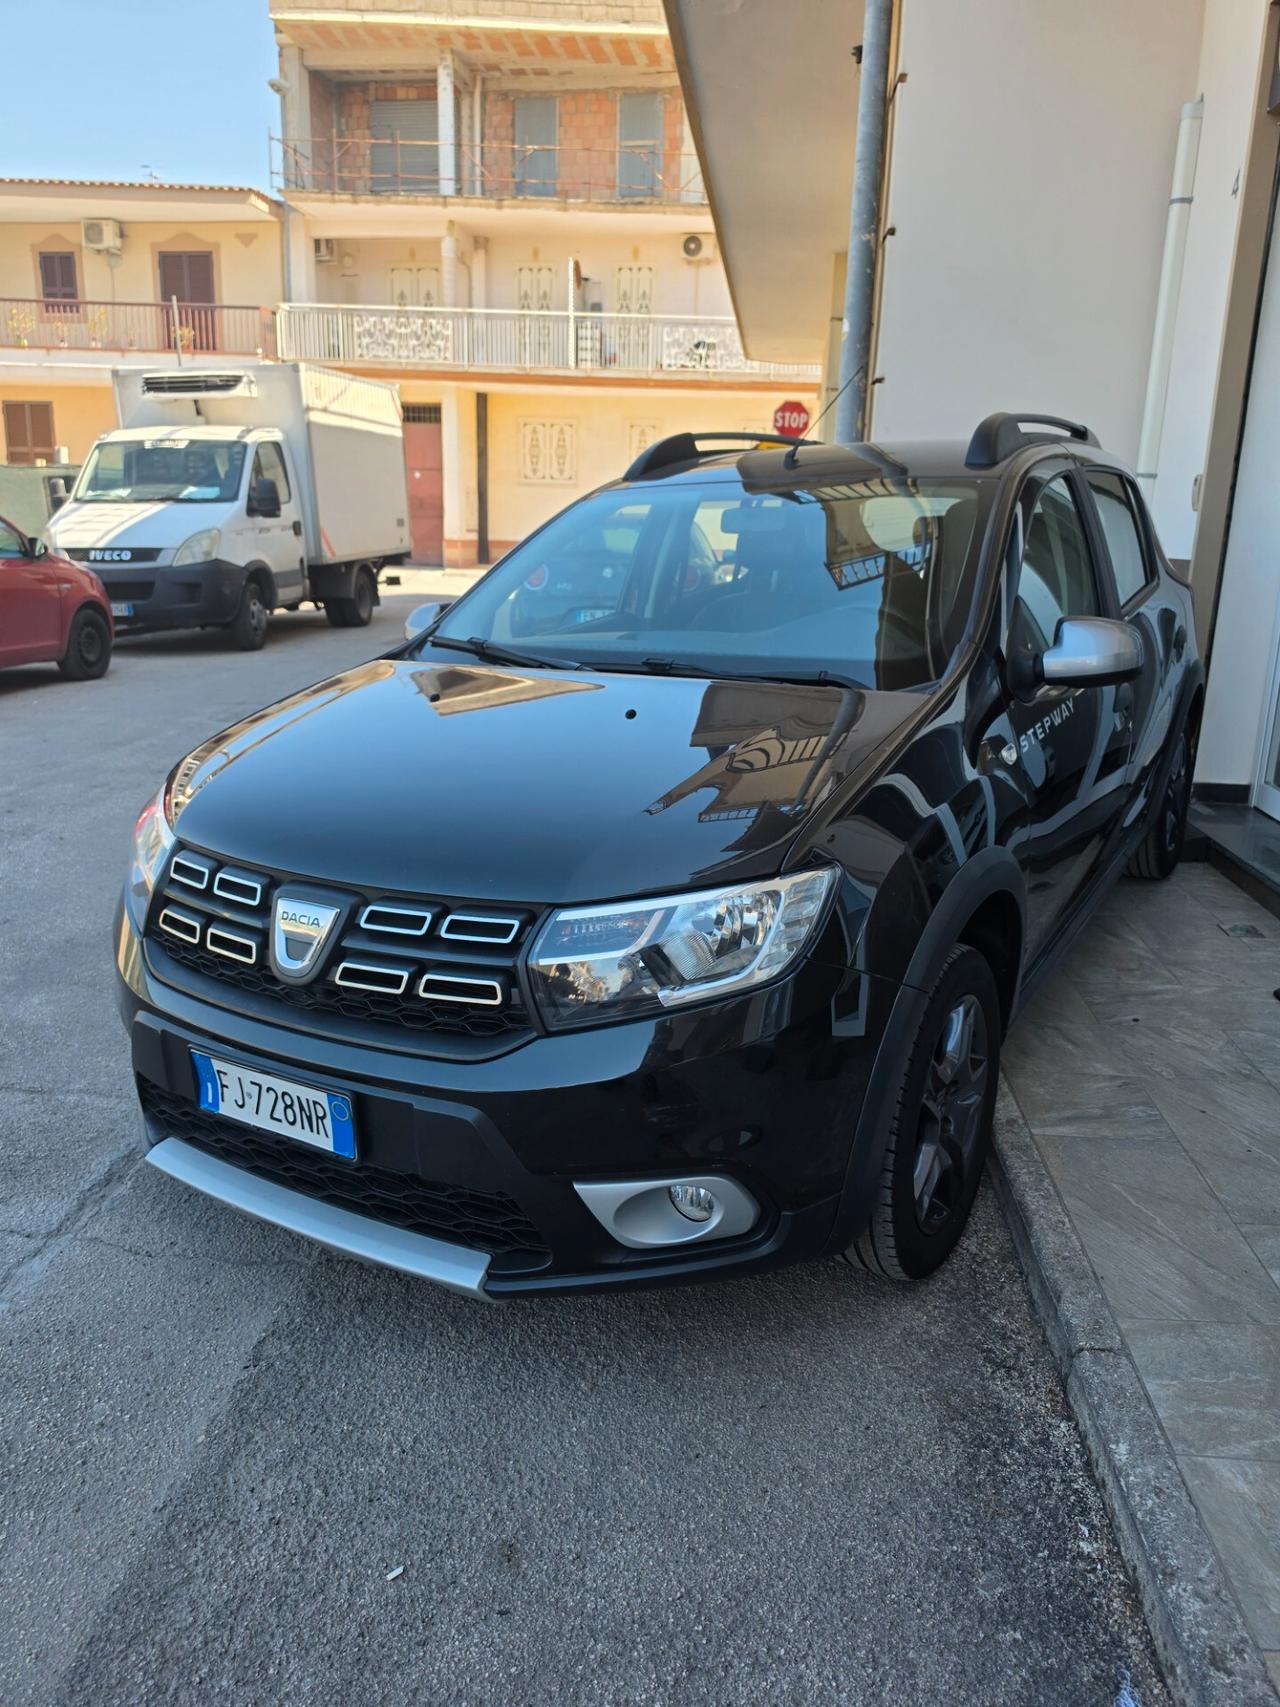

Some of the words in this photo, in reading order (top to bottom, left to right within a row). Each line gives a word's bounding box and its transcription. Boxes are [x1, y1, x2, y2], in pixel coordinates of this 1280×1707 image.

[775, 411, 808, 428] STOP
[89, 550, 132, 561] IVECO
[1020, 697, 1074, 753] STEPWAY
[281, 910, 321, 928] DACIA
